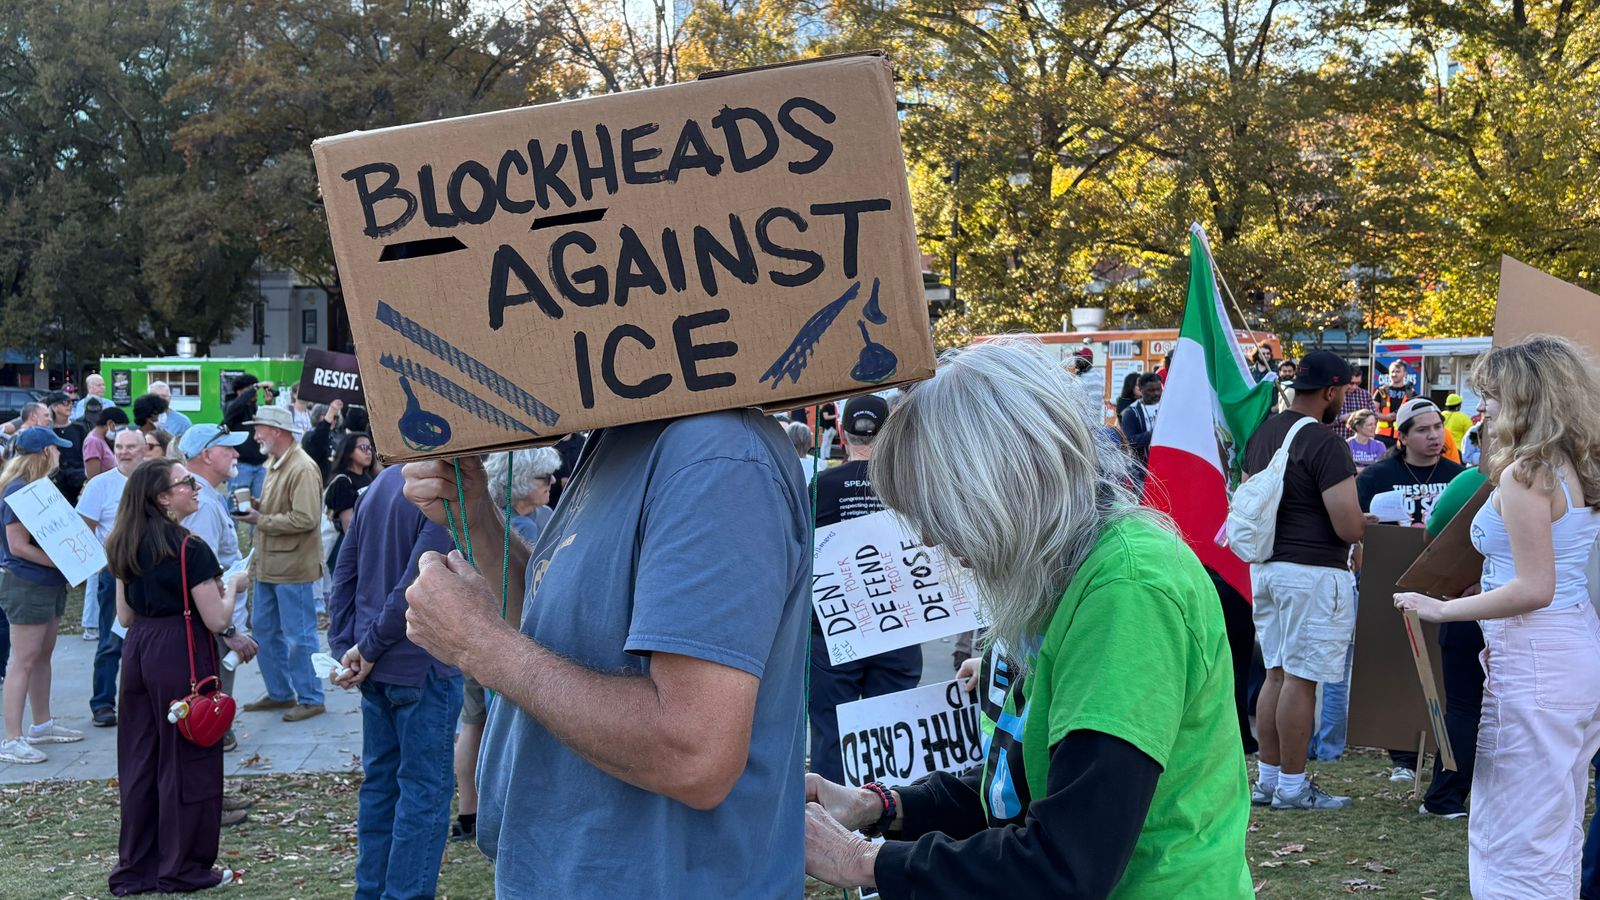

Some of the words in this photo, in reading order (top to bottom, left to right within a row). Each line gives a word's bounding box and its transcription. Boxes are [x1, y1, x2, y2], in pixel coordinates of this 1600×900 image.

[341, 97, 836, 239] BLOCKHEADS
[488, 199, 891, 330] AGAINST
[313, 367, 359, 390] RESIST.
[574, 308, 739, 409] ICE
[812, 572, 857, 637] DENY
[837, 556, 860, 593] POWER
[855, 544, 904, 633] DEFEND
[880, 551, 905, 593] PEOPLE
[900, 539, 951, 623] DEPOSE
[850, 599, 876, 638] THEIR
[897, 601, 921, 629] THE
[842, 721, 915, 788] GREED
